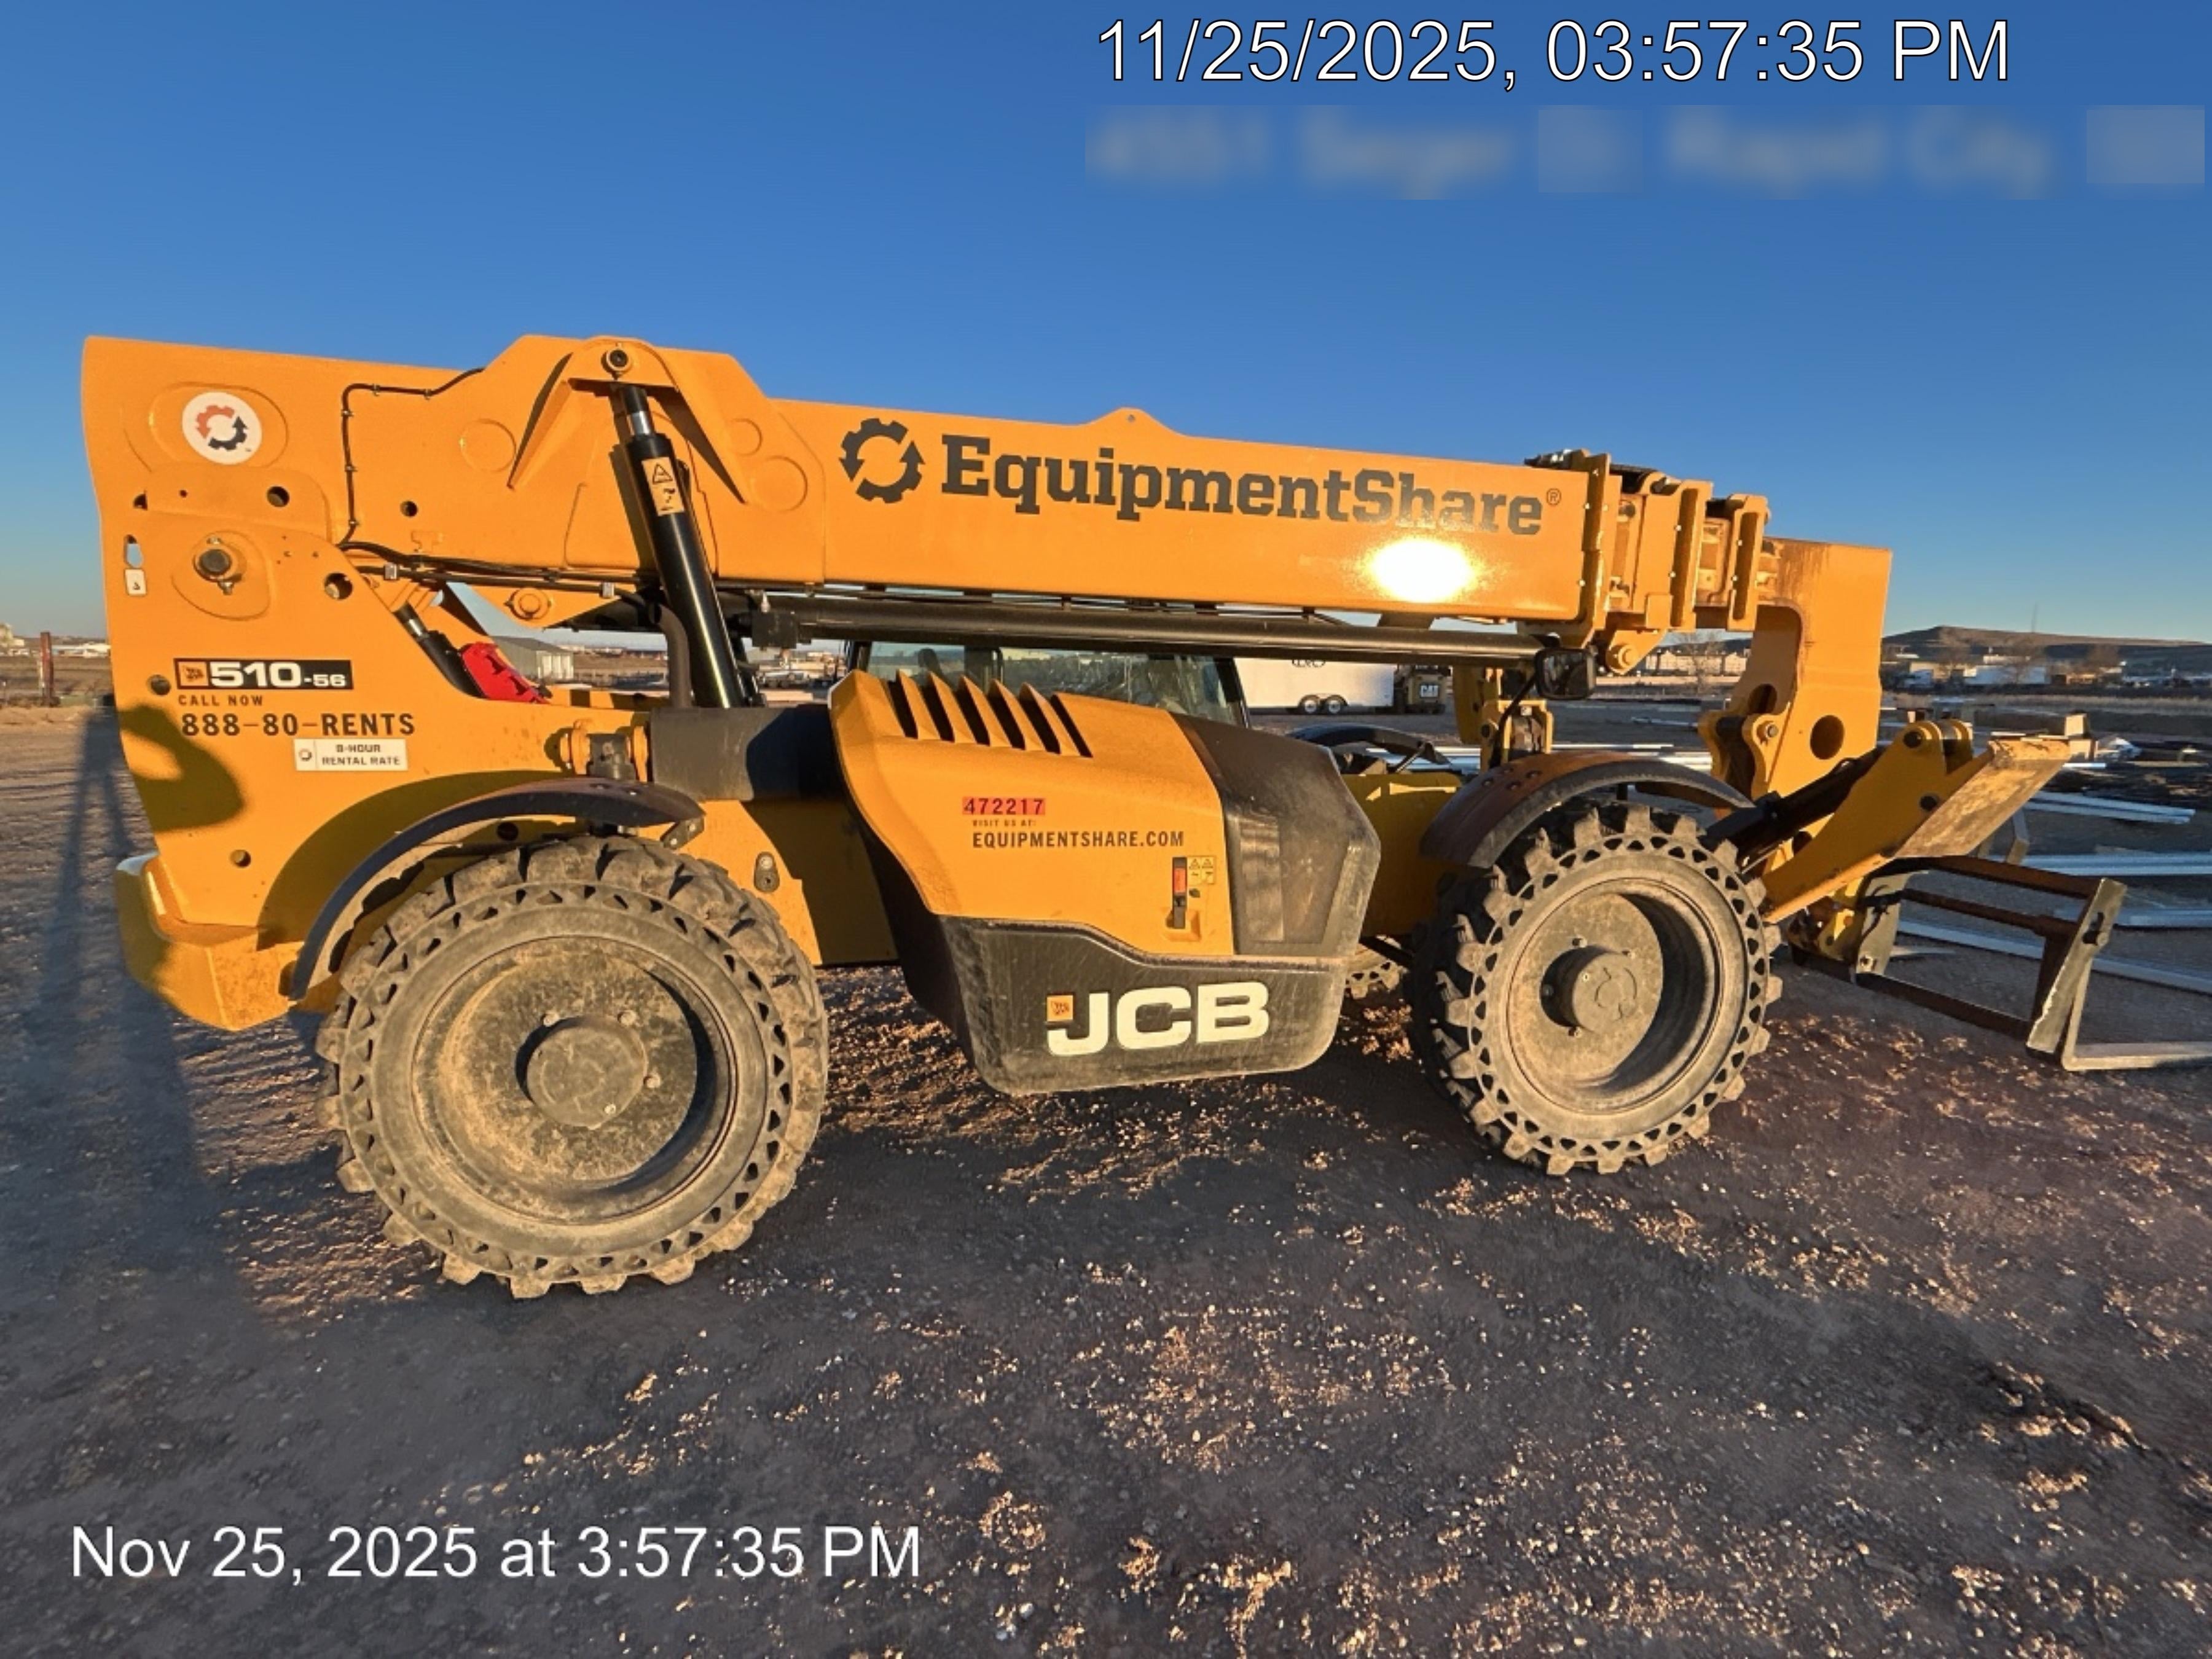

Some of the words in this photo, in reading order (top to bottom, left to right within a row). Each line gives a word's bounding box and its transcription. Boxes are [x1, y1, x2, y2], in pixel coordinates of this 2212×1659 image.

[178, 694, 219, 706] CALL
[228, 694, 263, 706] NOW
[182, 713, 415, 736] 888-80-RENTS
[322, 756, 367, 766] RENTAL
[370, 756, 401, 766] RATE
[963, 798, 1043, 815] 472217
[973, 831, 1184, 849] EQUIPMENTSHARE.COM
[1046, 981, 1269, 1057] JCB
